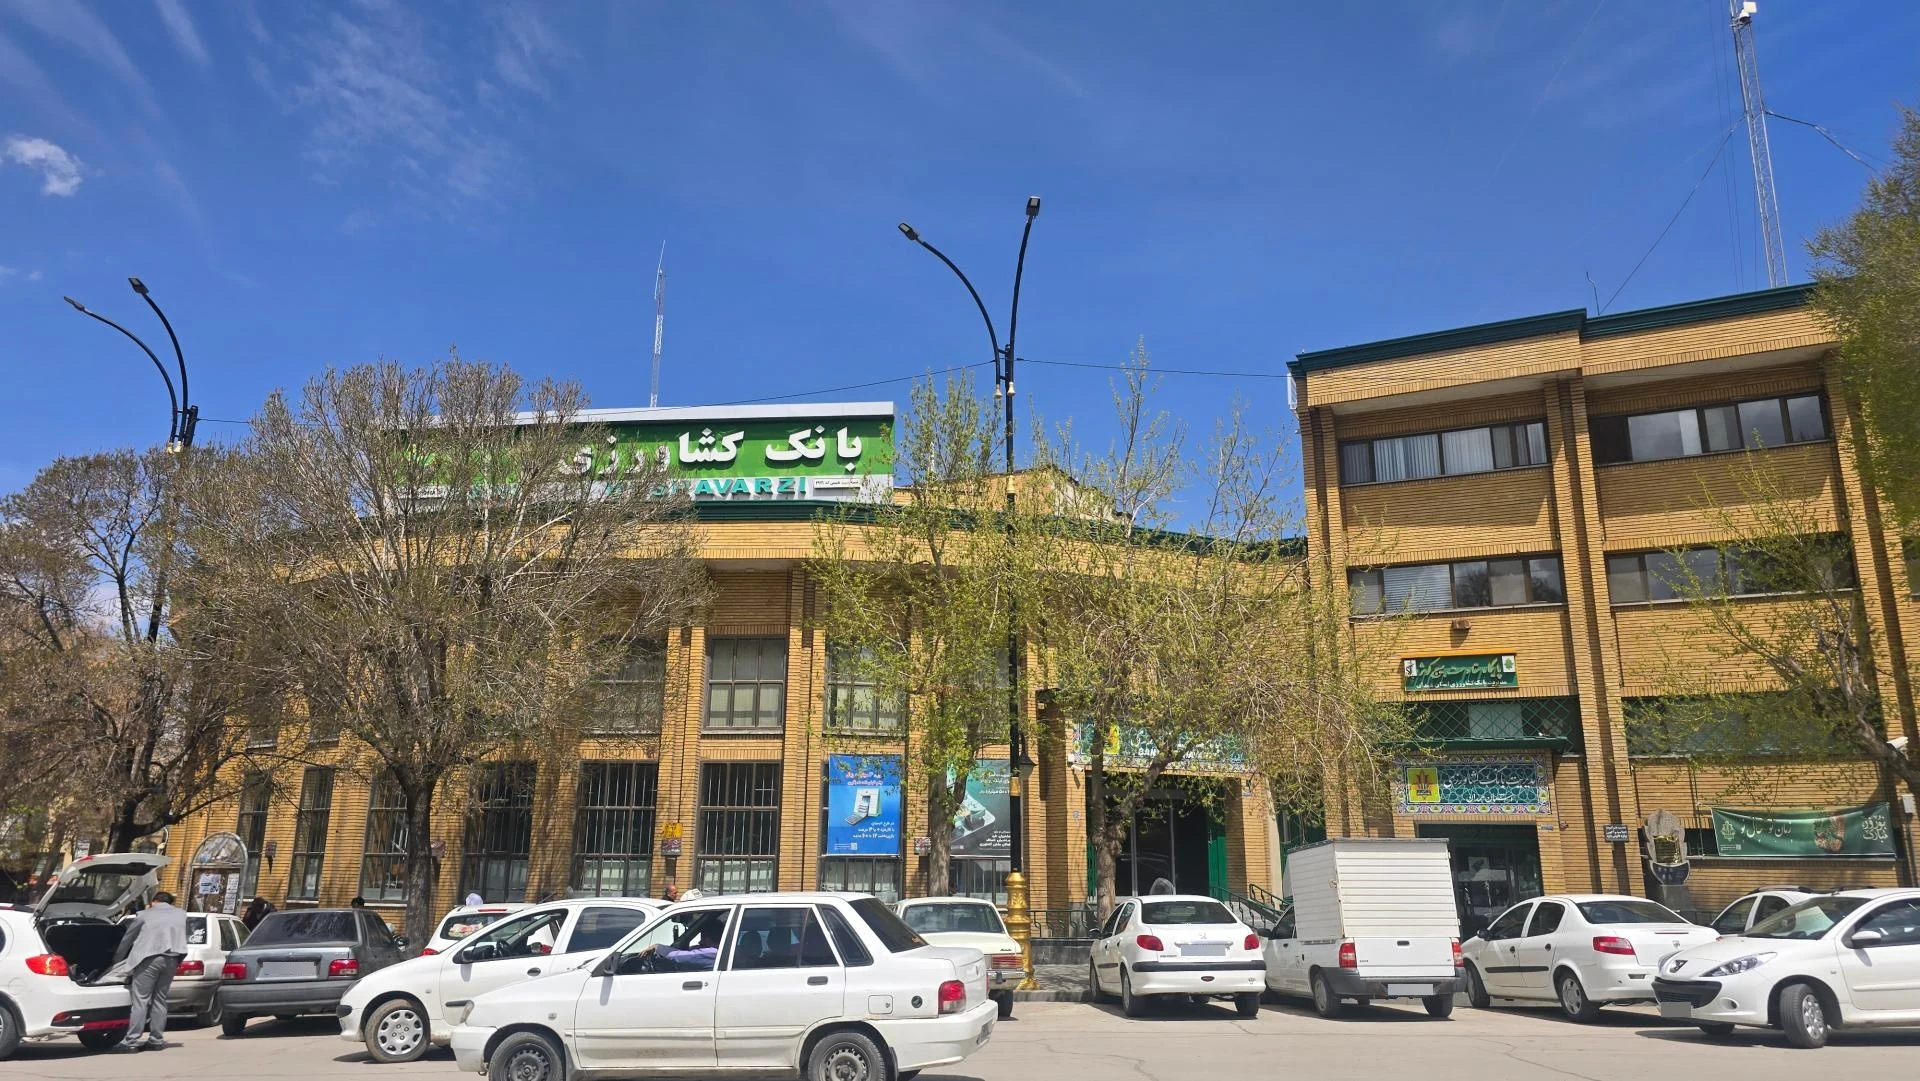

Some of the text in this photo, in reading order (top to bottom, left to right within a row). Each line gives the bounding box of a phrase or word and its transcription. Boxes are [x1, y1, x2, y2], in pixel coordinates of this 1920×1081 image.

[557, 424, 863, 475] بانک کشاورزی
[1443, 766, 1488, 789] کشاورزی
[1505, 774, 1536, 789] مدیریت
[1862, 828, 1889, 844] مبارک
